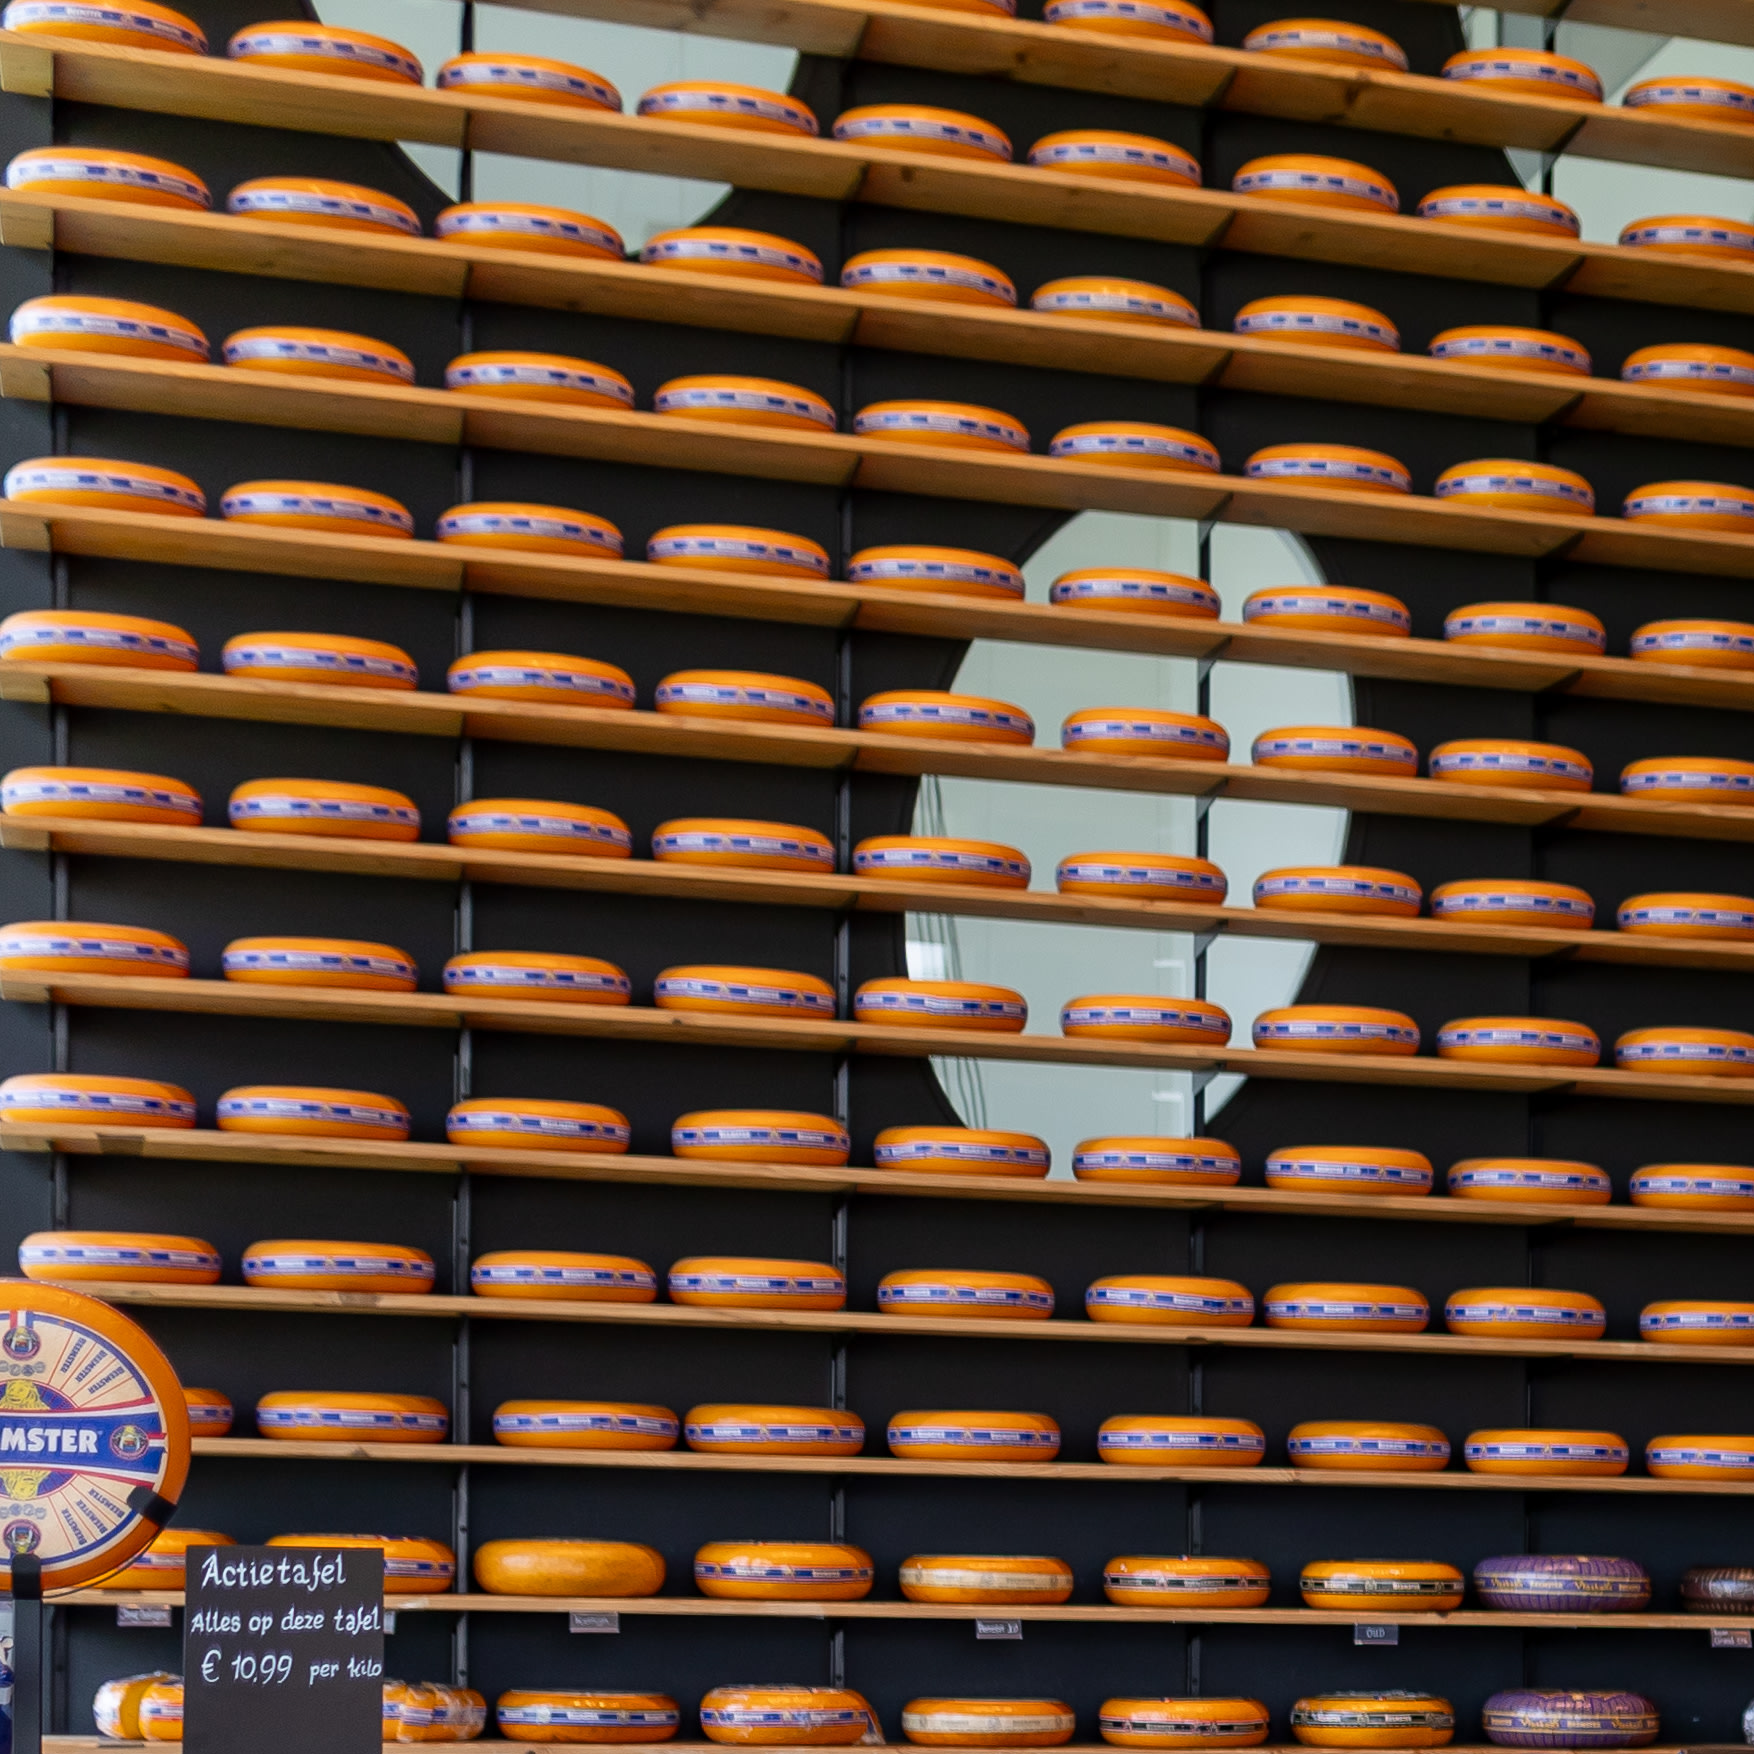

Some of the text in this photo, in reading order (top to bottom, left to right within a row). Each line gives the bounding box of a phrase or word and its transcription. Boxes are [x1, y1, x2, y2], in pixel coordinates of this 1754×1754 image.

[1, 1427, 98, 1453] MSTER
[200, 1552, 346, 1592] Actietafel
[191, 1609, 241, 1633] Alles
[248, 1614, 273, 1636] op
[281, 1607, 324, 1632] deze
[334, 1605, 381, 1636] tafel
[201, 1649, 222, 1683] €
[309, 1661, 339, 1686] per
[347, 1658, 382, 1677] kilo
